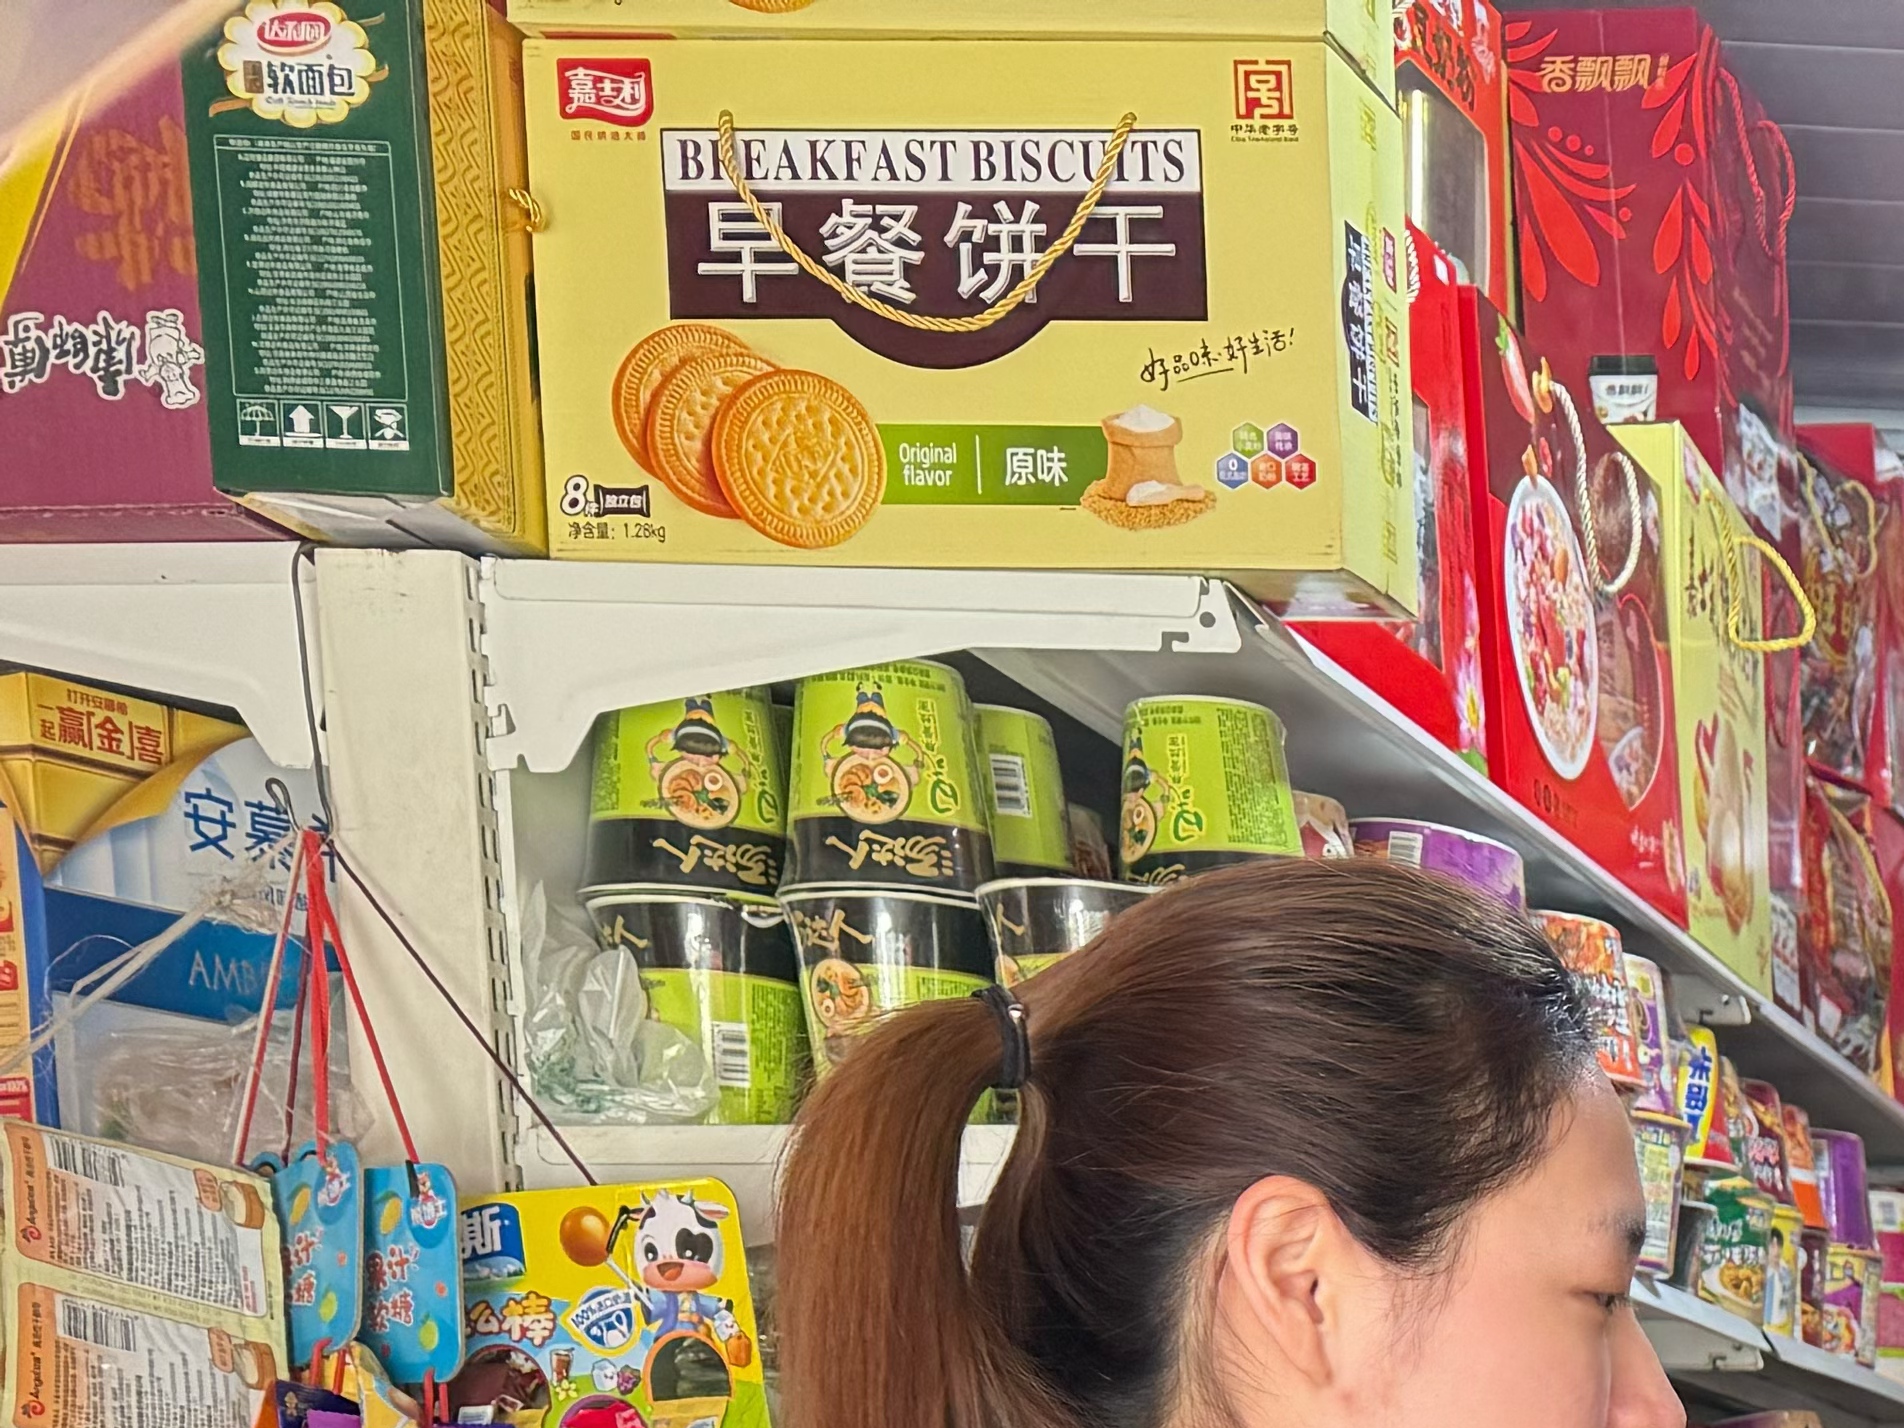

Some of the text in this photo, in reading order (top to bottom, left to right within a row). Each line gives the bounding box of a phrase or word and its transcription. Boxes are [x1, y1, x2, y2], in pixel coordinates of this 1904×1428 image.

[263, 63, 352, 99] 软面包
[565, 67, 647, 115] 嘉士利
[1541, 54, 1651, 91] 香飘飘
[680, 139, 1186, 184] BREAKFAST BISCUITS
[698, 199, 1177, 305] 早餐饼干
[898, 443, 957, 465] Original
[1005, 447, 1068, 487] 原味
[903, 465, 953, 487] flavor
